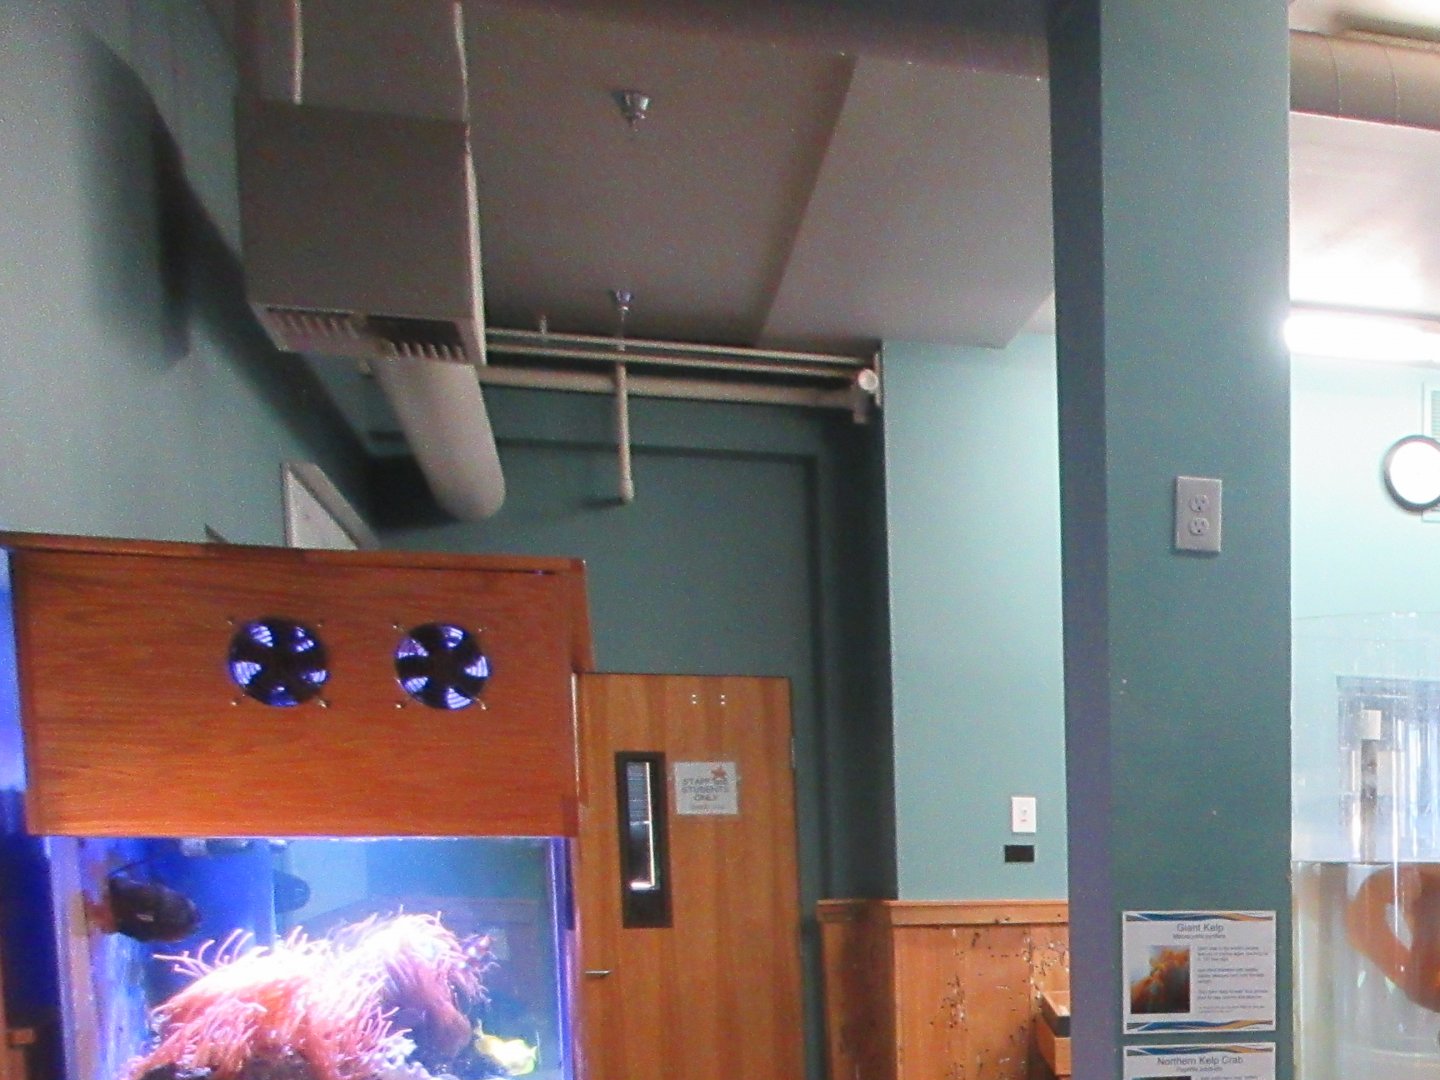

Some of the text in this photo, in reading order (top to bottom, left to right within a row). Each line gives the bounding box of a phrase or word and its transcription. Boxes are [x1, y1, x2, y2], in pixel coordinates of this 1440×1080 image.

[1176, 923, 1224, 934] Giant Kelp
[1157, 1055, 1244, 1066] Northern Kelp Crab
